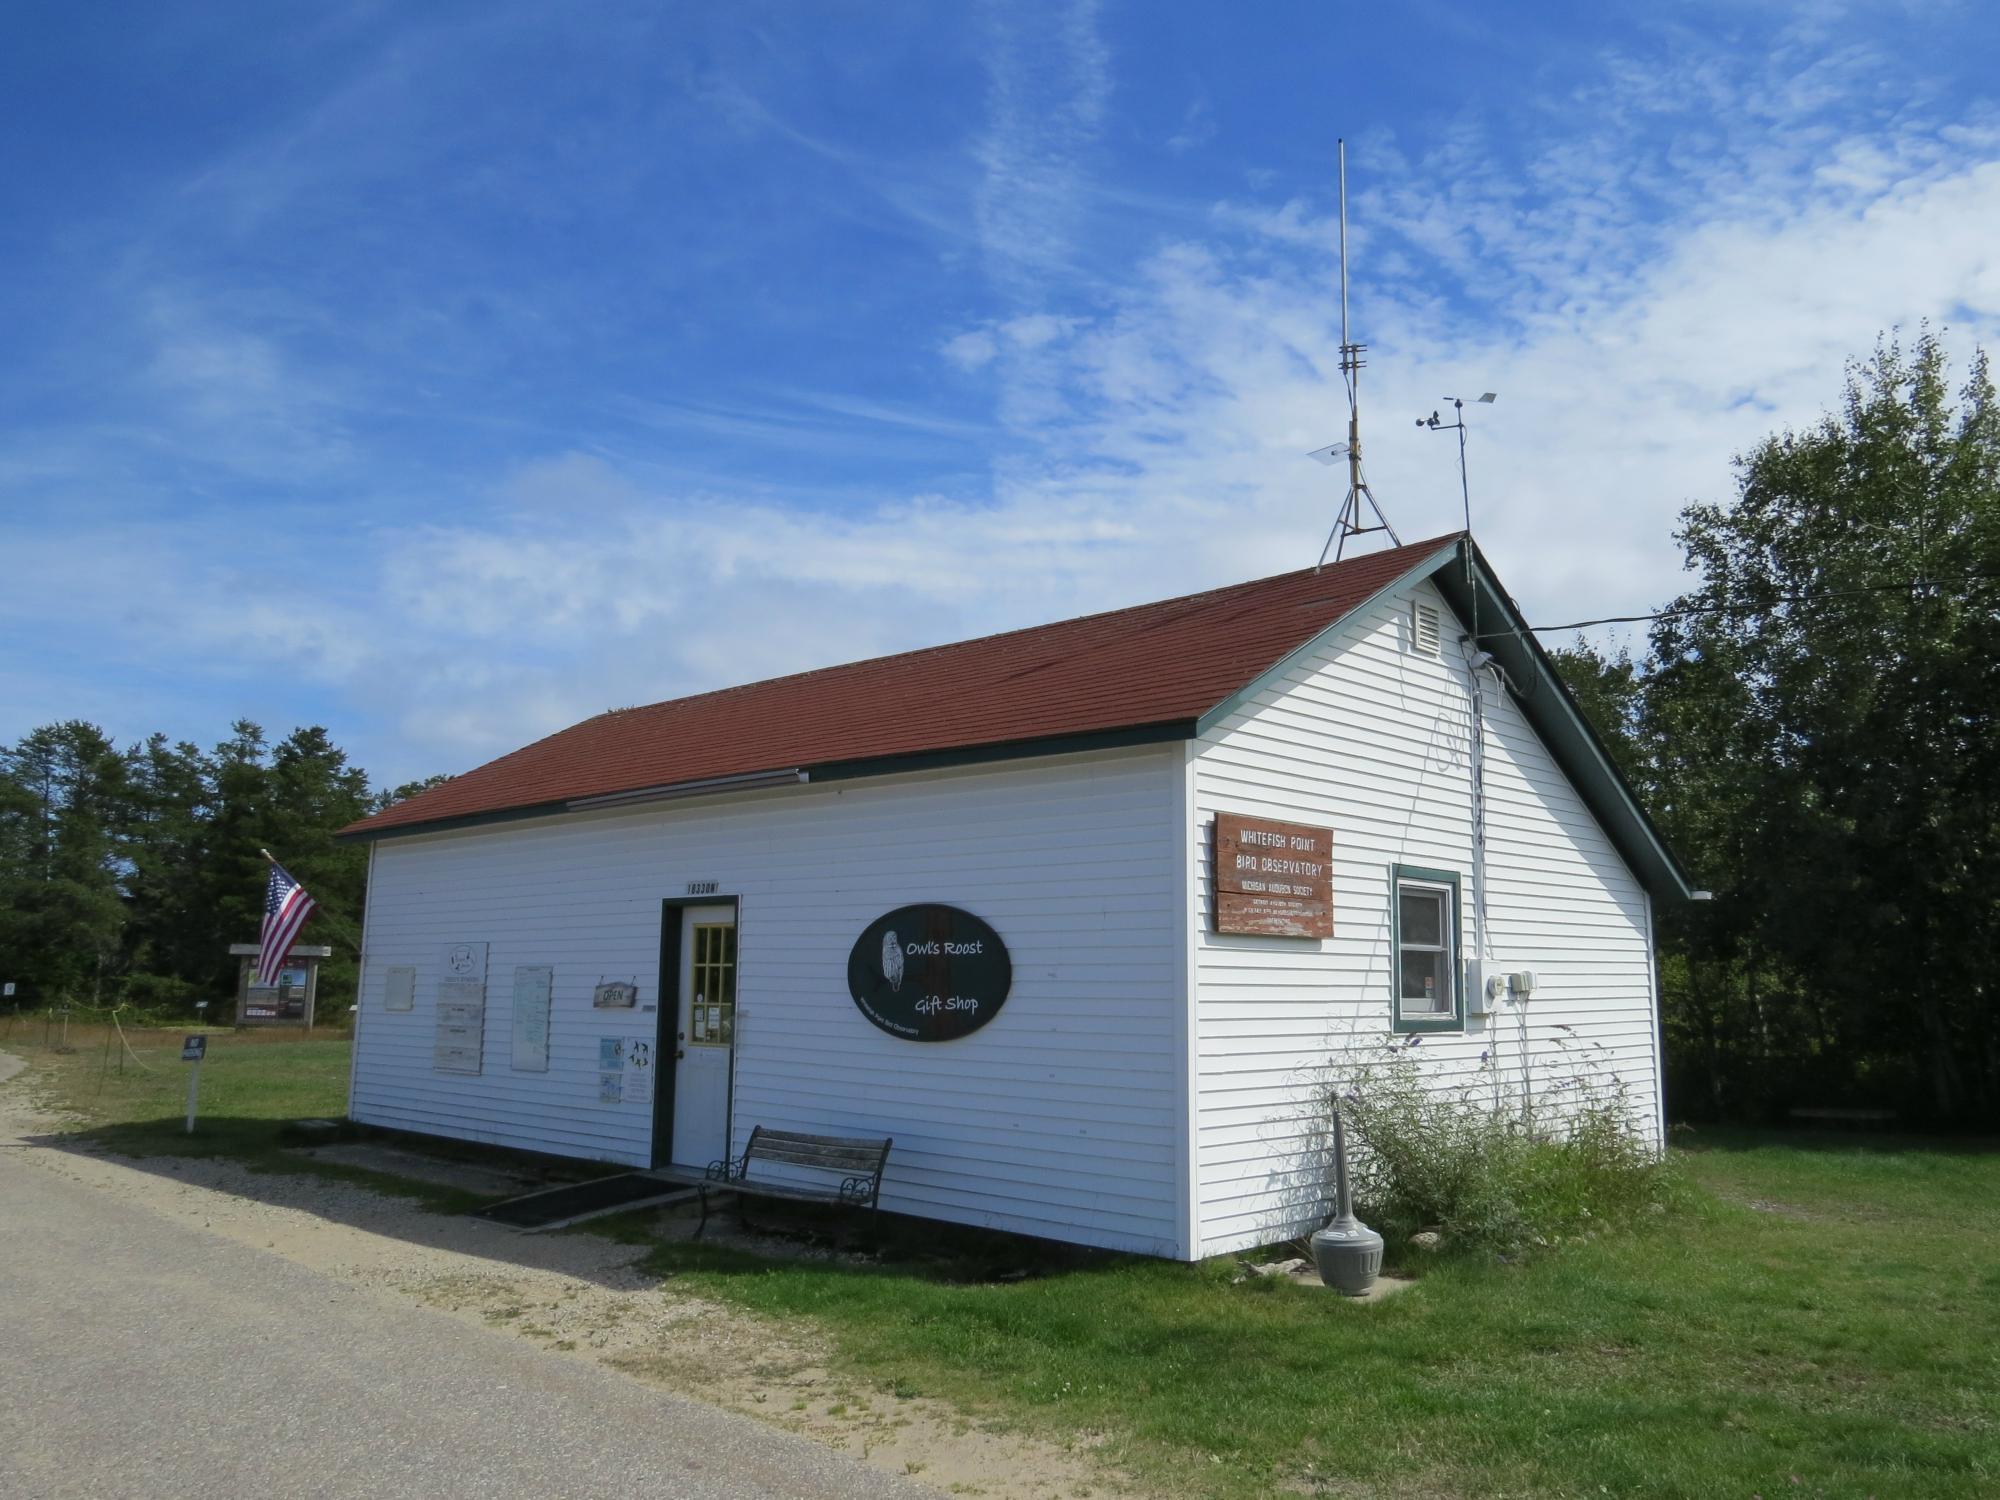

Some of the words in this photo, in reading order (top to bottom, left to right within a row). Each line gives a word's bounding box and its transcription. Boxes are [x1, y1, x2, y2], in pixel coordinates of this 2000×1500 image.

[1240, 829, 1286, 848] WHITEFISH
[1290, 836, 1316, 851] POINT
[1236, 854, 1257, 870] BIRD
[1261, 858, 1323, 876] OBSERVATORY
[906, 940, 941, 955] Owl's
[944, 939, 983, 955] Roost
[602, 989, 625, 1001] OPEN
[915, 995, 942, 1016] Gift
[944, 995, 979, 1016] Shop
